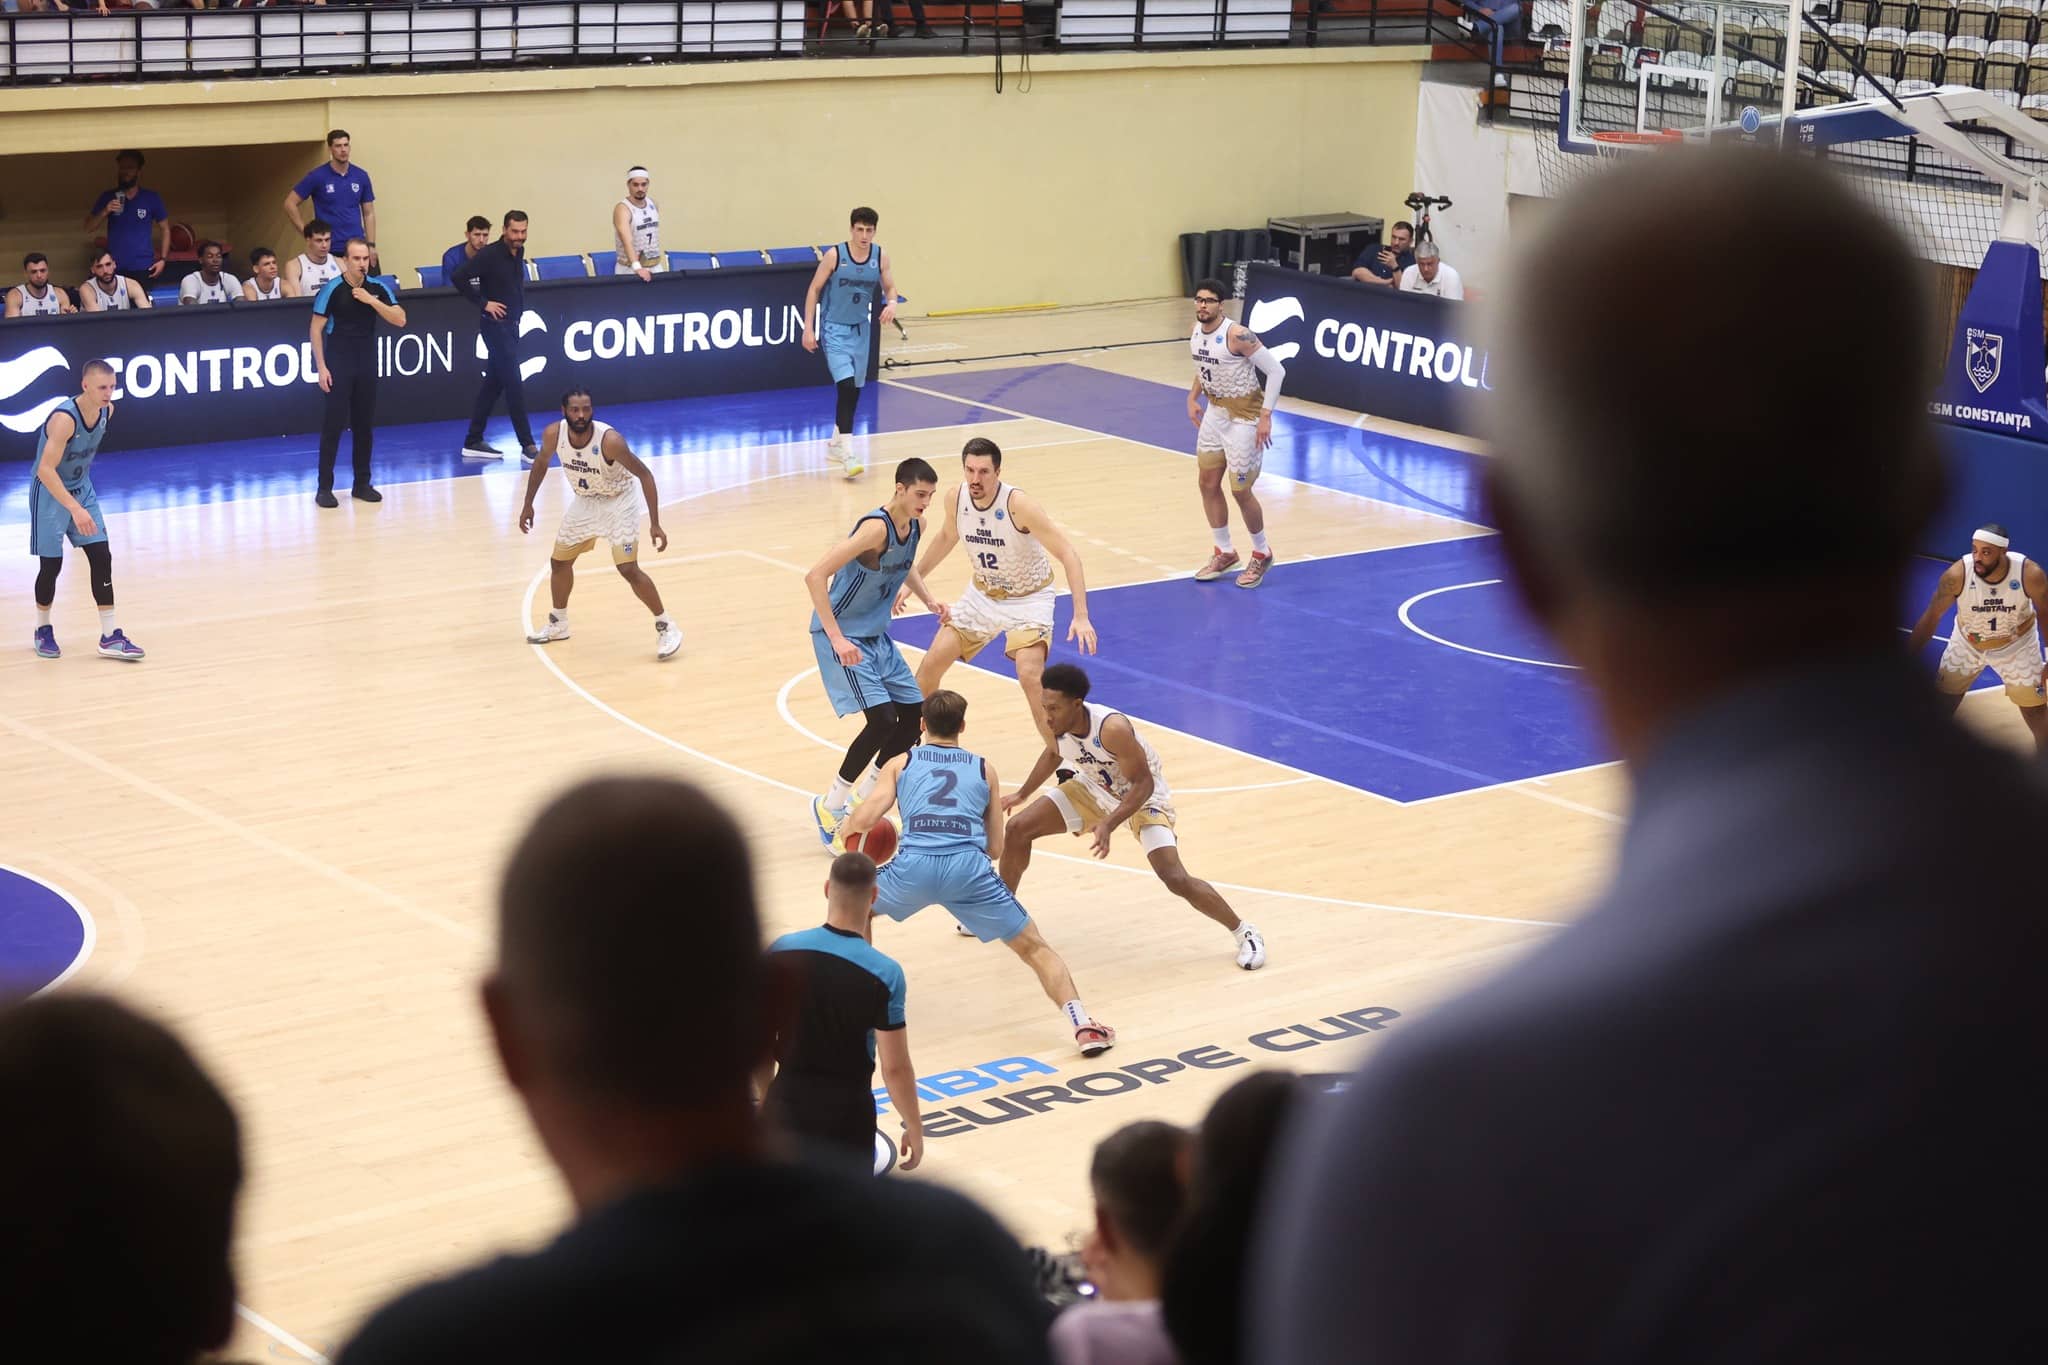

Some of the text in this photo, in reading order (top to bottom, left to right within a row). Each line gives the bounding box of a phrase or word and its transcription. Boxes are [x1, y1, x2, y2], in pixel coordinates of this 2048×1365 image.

[645, 232, 653, 246] 7
[1966, 327, 1985, 338] CSM
[578, 477, 589, 490] 4
[977, 551, 999, 571] 12
[1987, 616, 1997, 632] 1
[927, 768, 959, 809] 2
[900, 1006, 1402, 1138] EUROPE CUP
